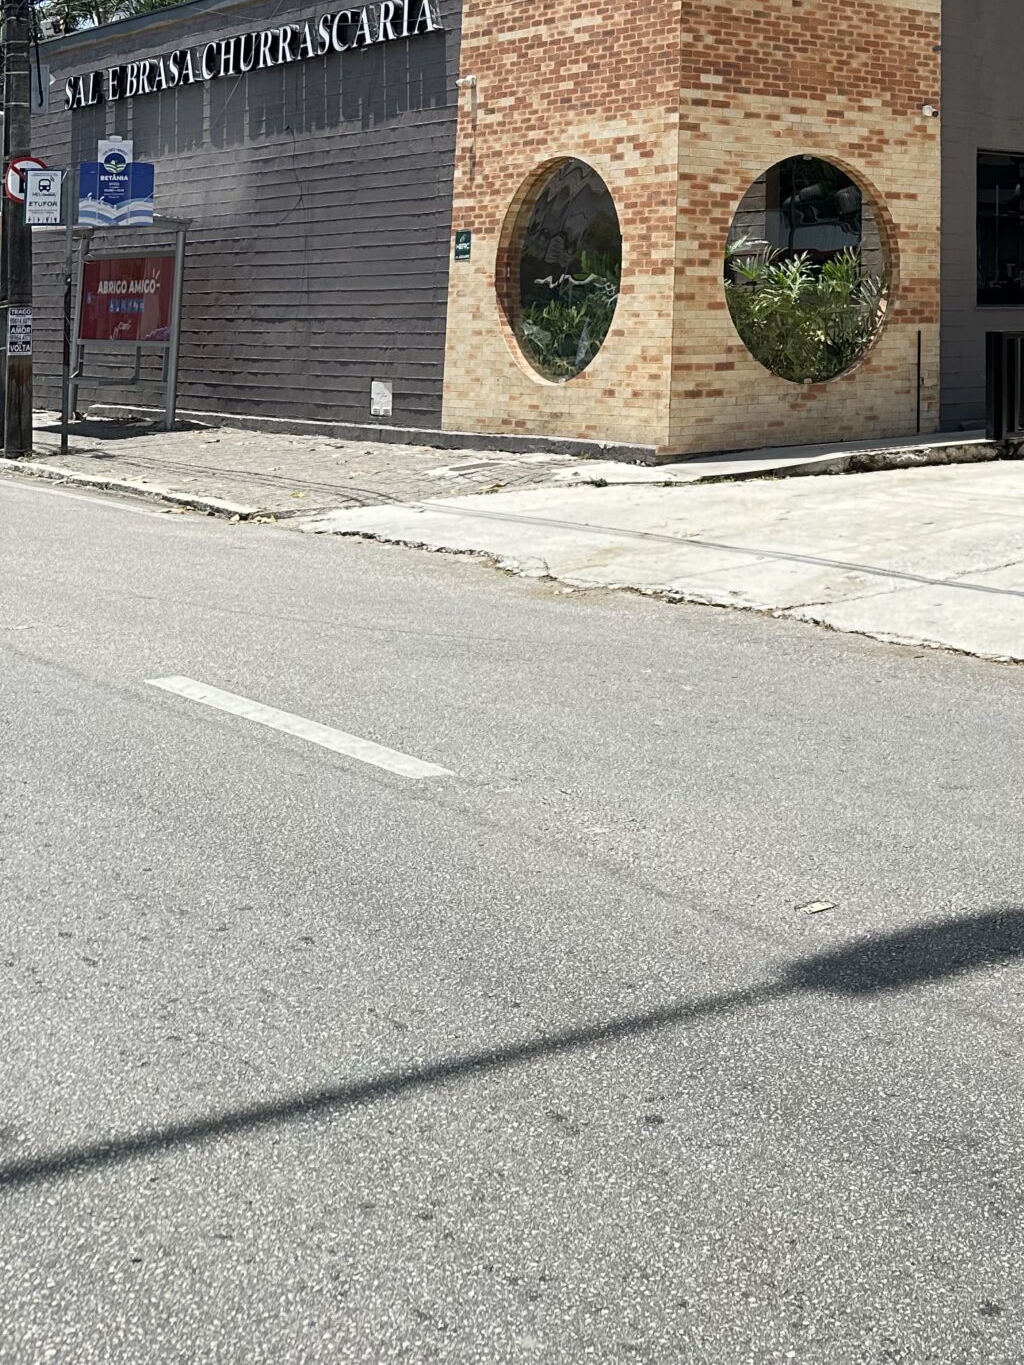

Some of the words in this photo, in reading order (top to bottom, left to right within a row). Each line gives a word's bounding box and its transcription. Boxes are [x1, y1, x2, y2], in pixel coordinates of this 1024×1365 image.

[64, 72, 99, 110] SAL
[107, 66, 120, 101] E
[125, 49, 195, 98] BRASA
[97, 280, 127, 294] ABRIGO
[128, 279, 156, 294] AMIGO
[11, 326, 31, 334] AMOR
[10, 344, 31, 352] VOLTA
